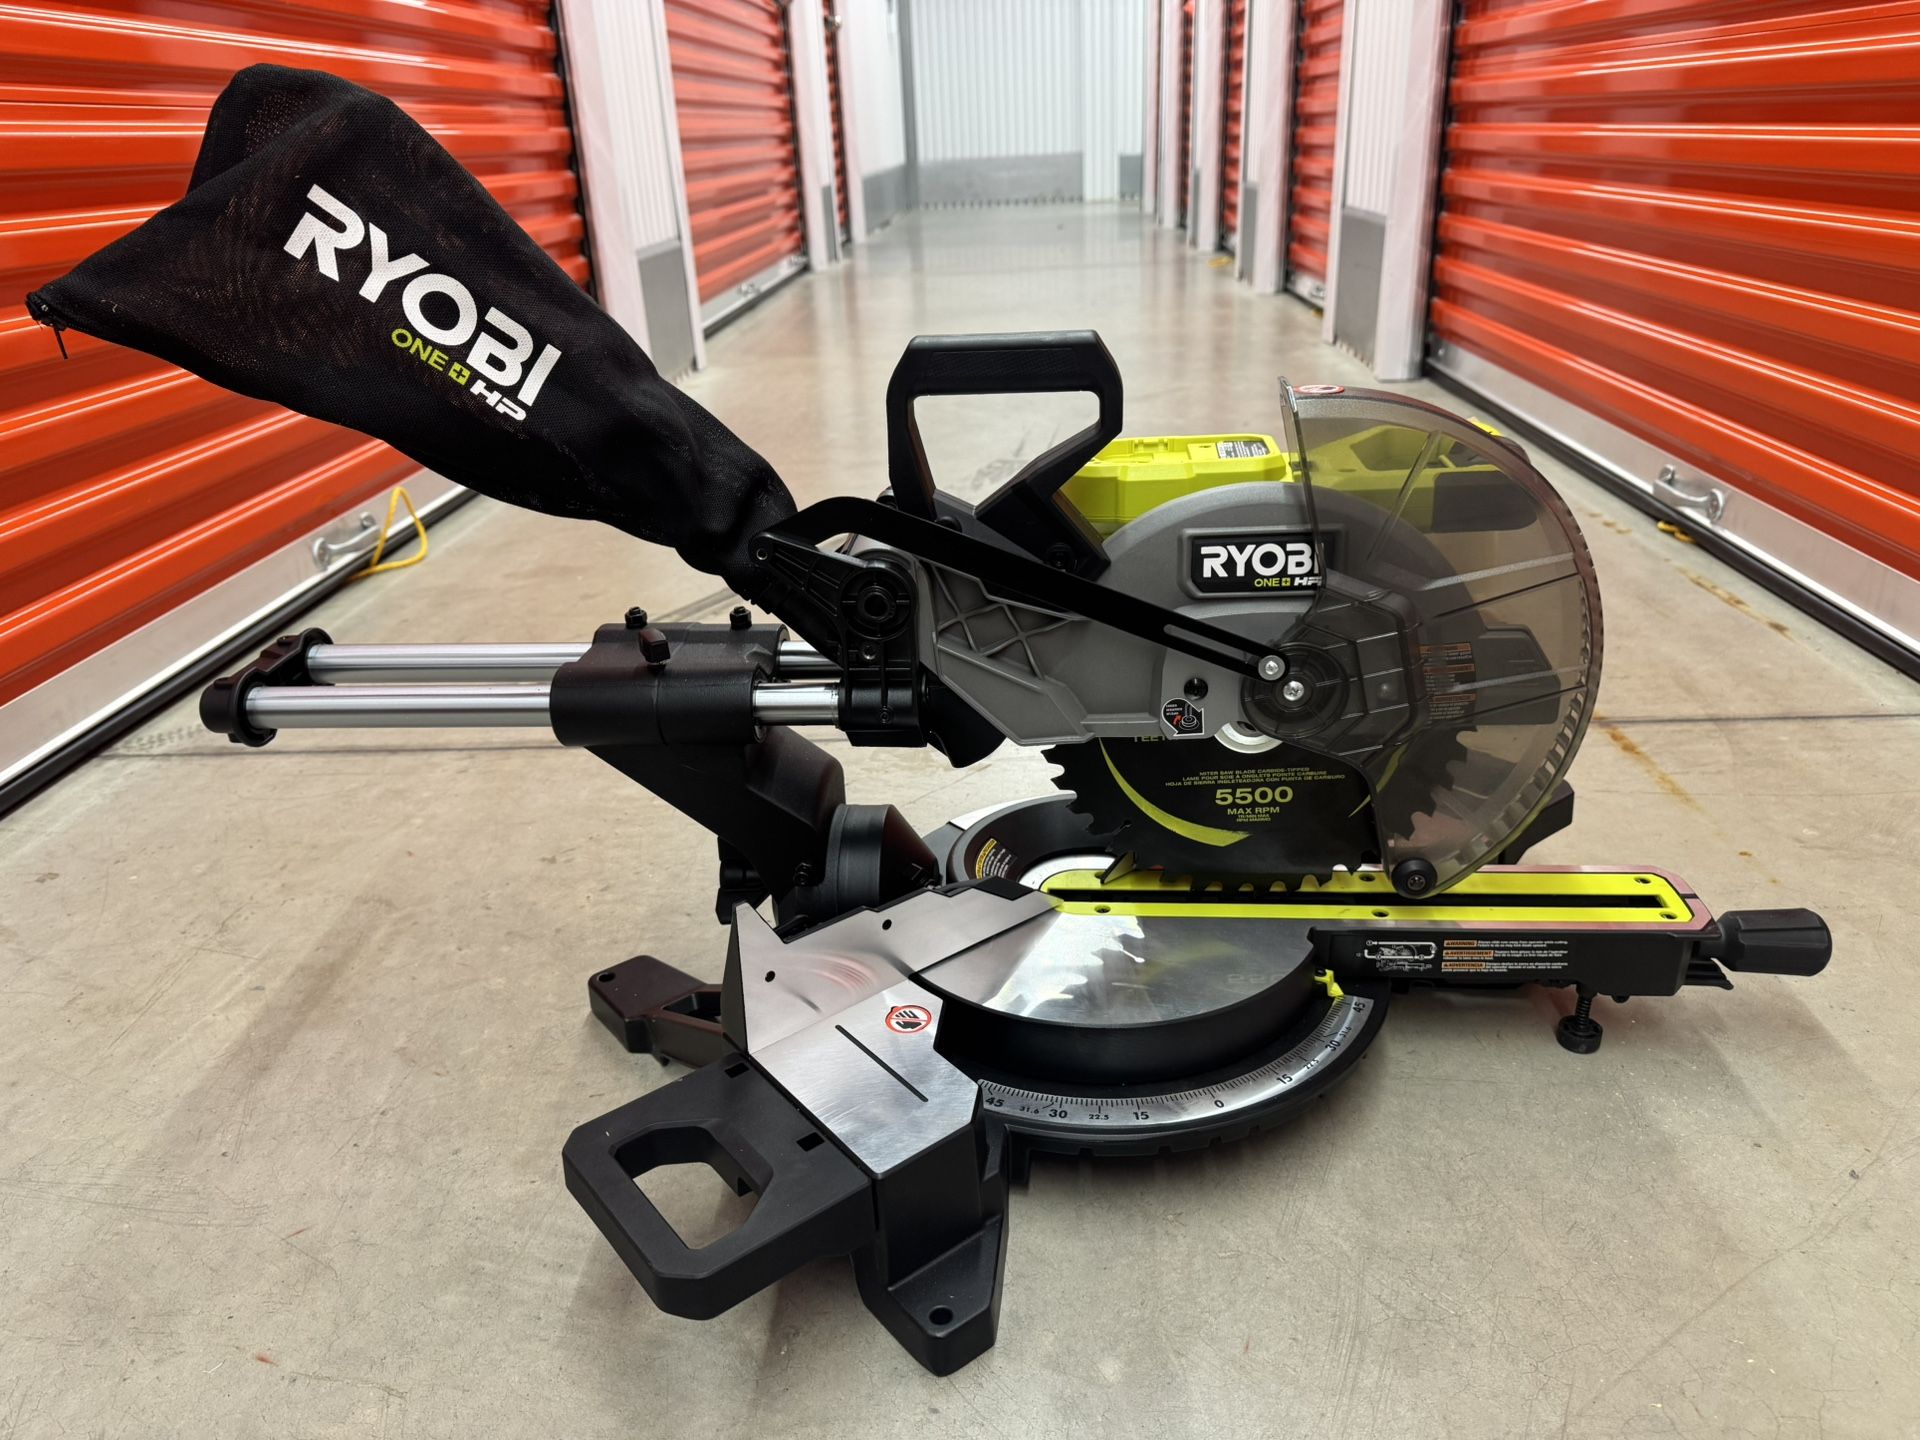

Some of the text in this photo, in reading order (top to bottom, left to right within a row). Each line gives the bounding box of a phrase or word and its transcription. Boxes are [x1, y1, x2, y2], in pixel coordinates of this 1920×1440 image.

[283, 183, 562, 407] RYOBI
[470, 379, 526, 421] HP
[1215, 786, 1294, 805] 5500
[1227, 806, 1280, 815] MAX RPM
[985, 1097, 1004, 1108] 45
[1019, 1106, 1040, 1114] 31.6
[1048, 1109, 1068, 1118] 30
[1133, 1111, 1149, 1120] 15
[1214, 1100, 1225, 1108] 0
[1276, 1073, 1293, 1085] 15
[1305, 1058, 1321, 1070] 22.5
[1325, 1039, 1341, 1051] 30
[1353, 1002, 1366, 1014] 45
